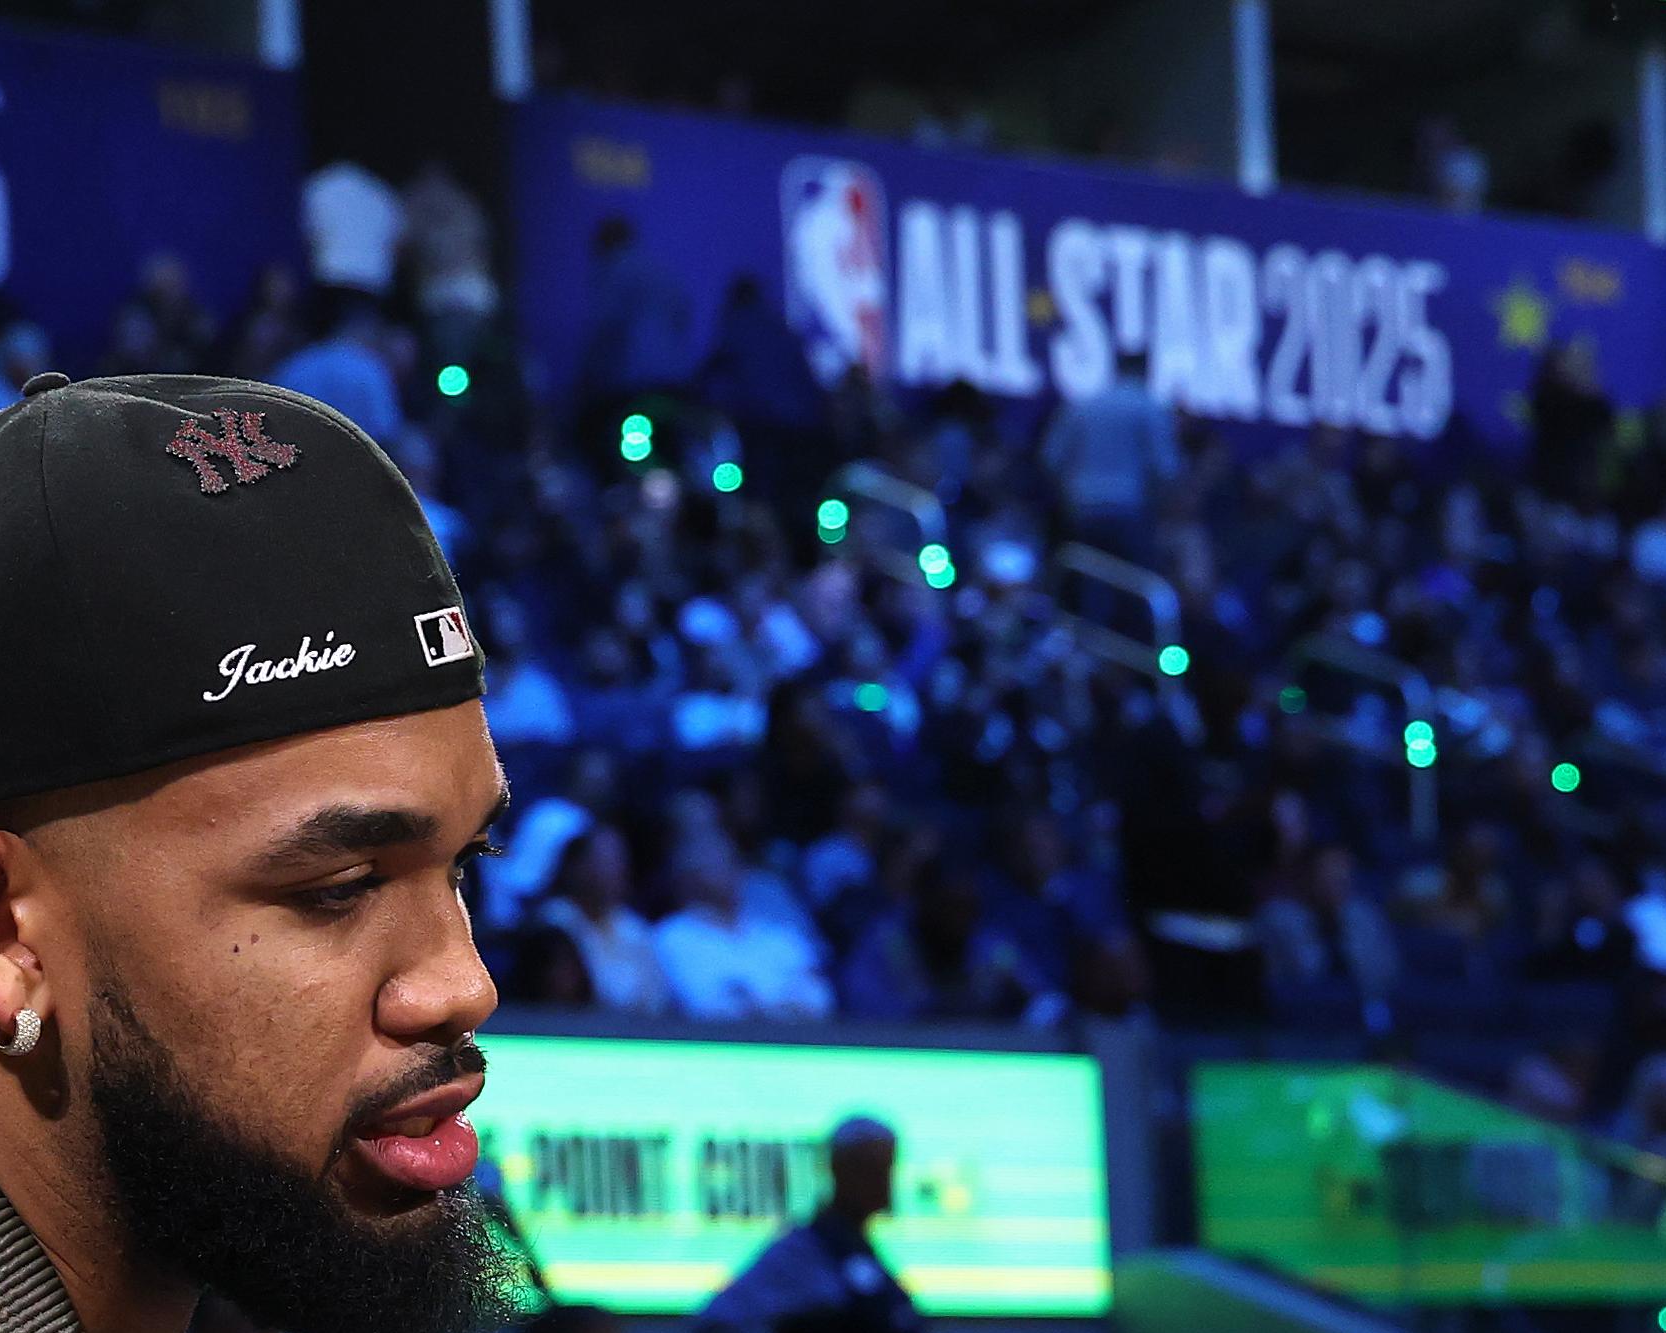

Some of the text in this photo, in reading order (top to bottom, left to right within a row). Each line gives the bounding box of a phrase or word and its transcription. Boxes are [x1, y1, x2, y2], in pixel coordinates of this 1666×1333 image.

[896, 199, 1453, 440] ALL STAR 2025
[202, 631, 357, 702] Jackie
